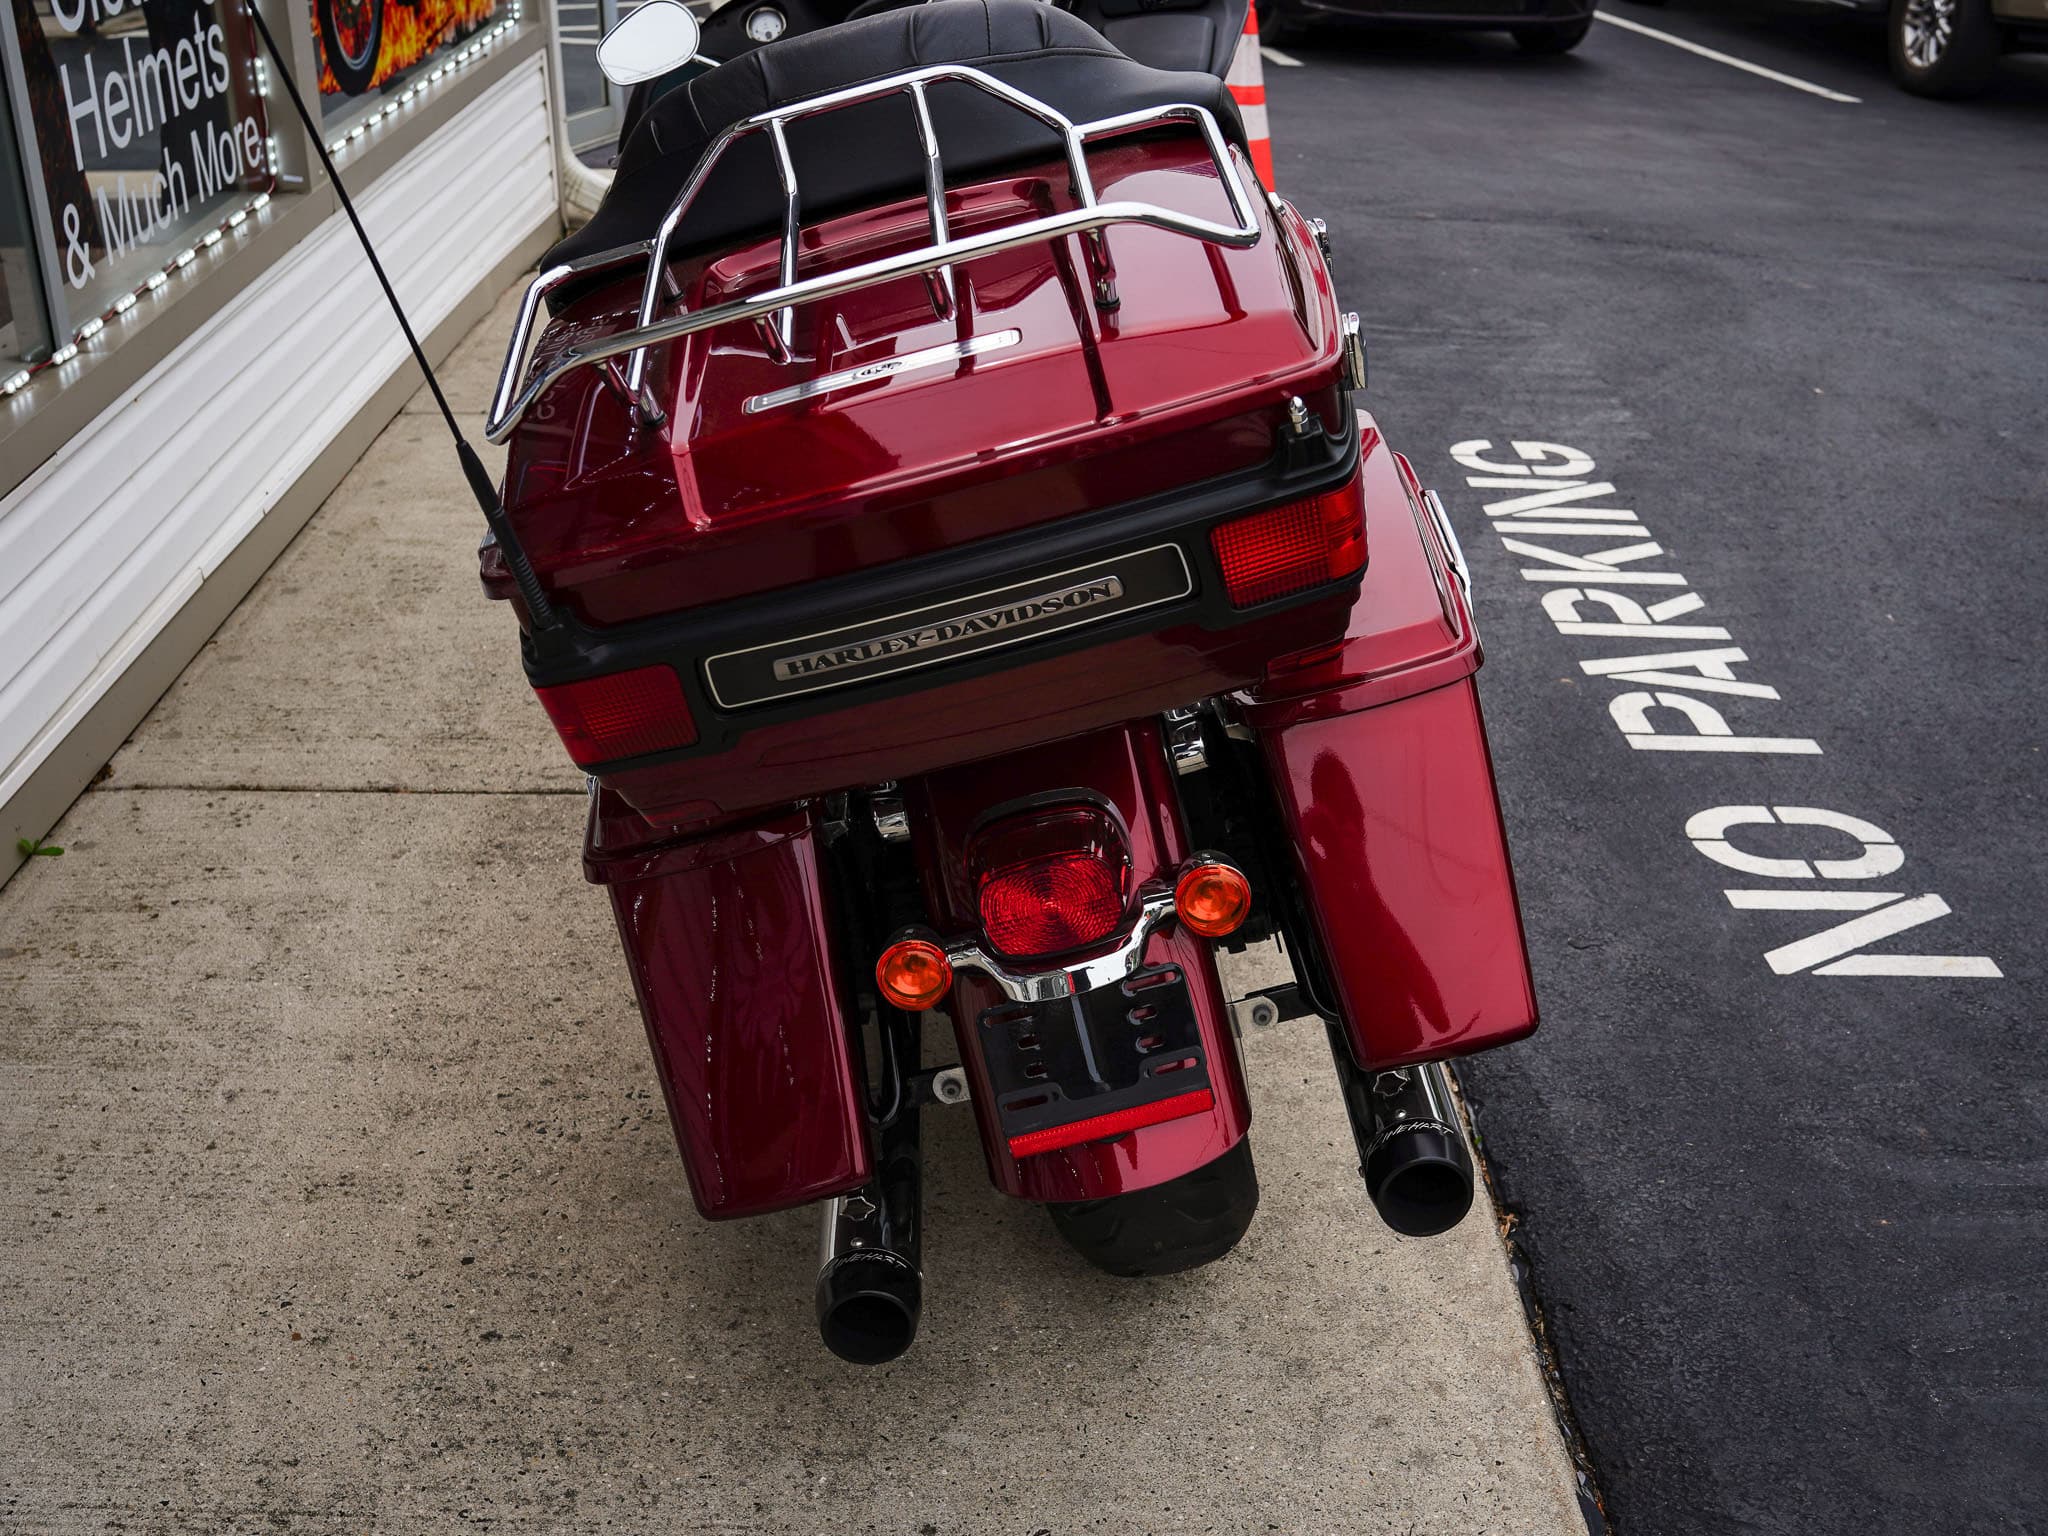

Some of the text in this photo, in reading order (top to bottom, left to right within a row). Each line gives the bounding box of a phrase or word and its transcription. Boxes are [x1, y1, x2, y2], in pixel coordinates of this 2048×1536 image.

[60, 9, 230, 172] Helmets
[63, 116, 261, 290] & Much More
[783, 582, 1115, 677] HARLEY-DAVIDSON
[1449, 438, 2004, 978] NO PARKING
